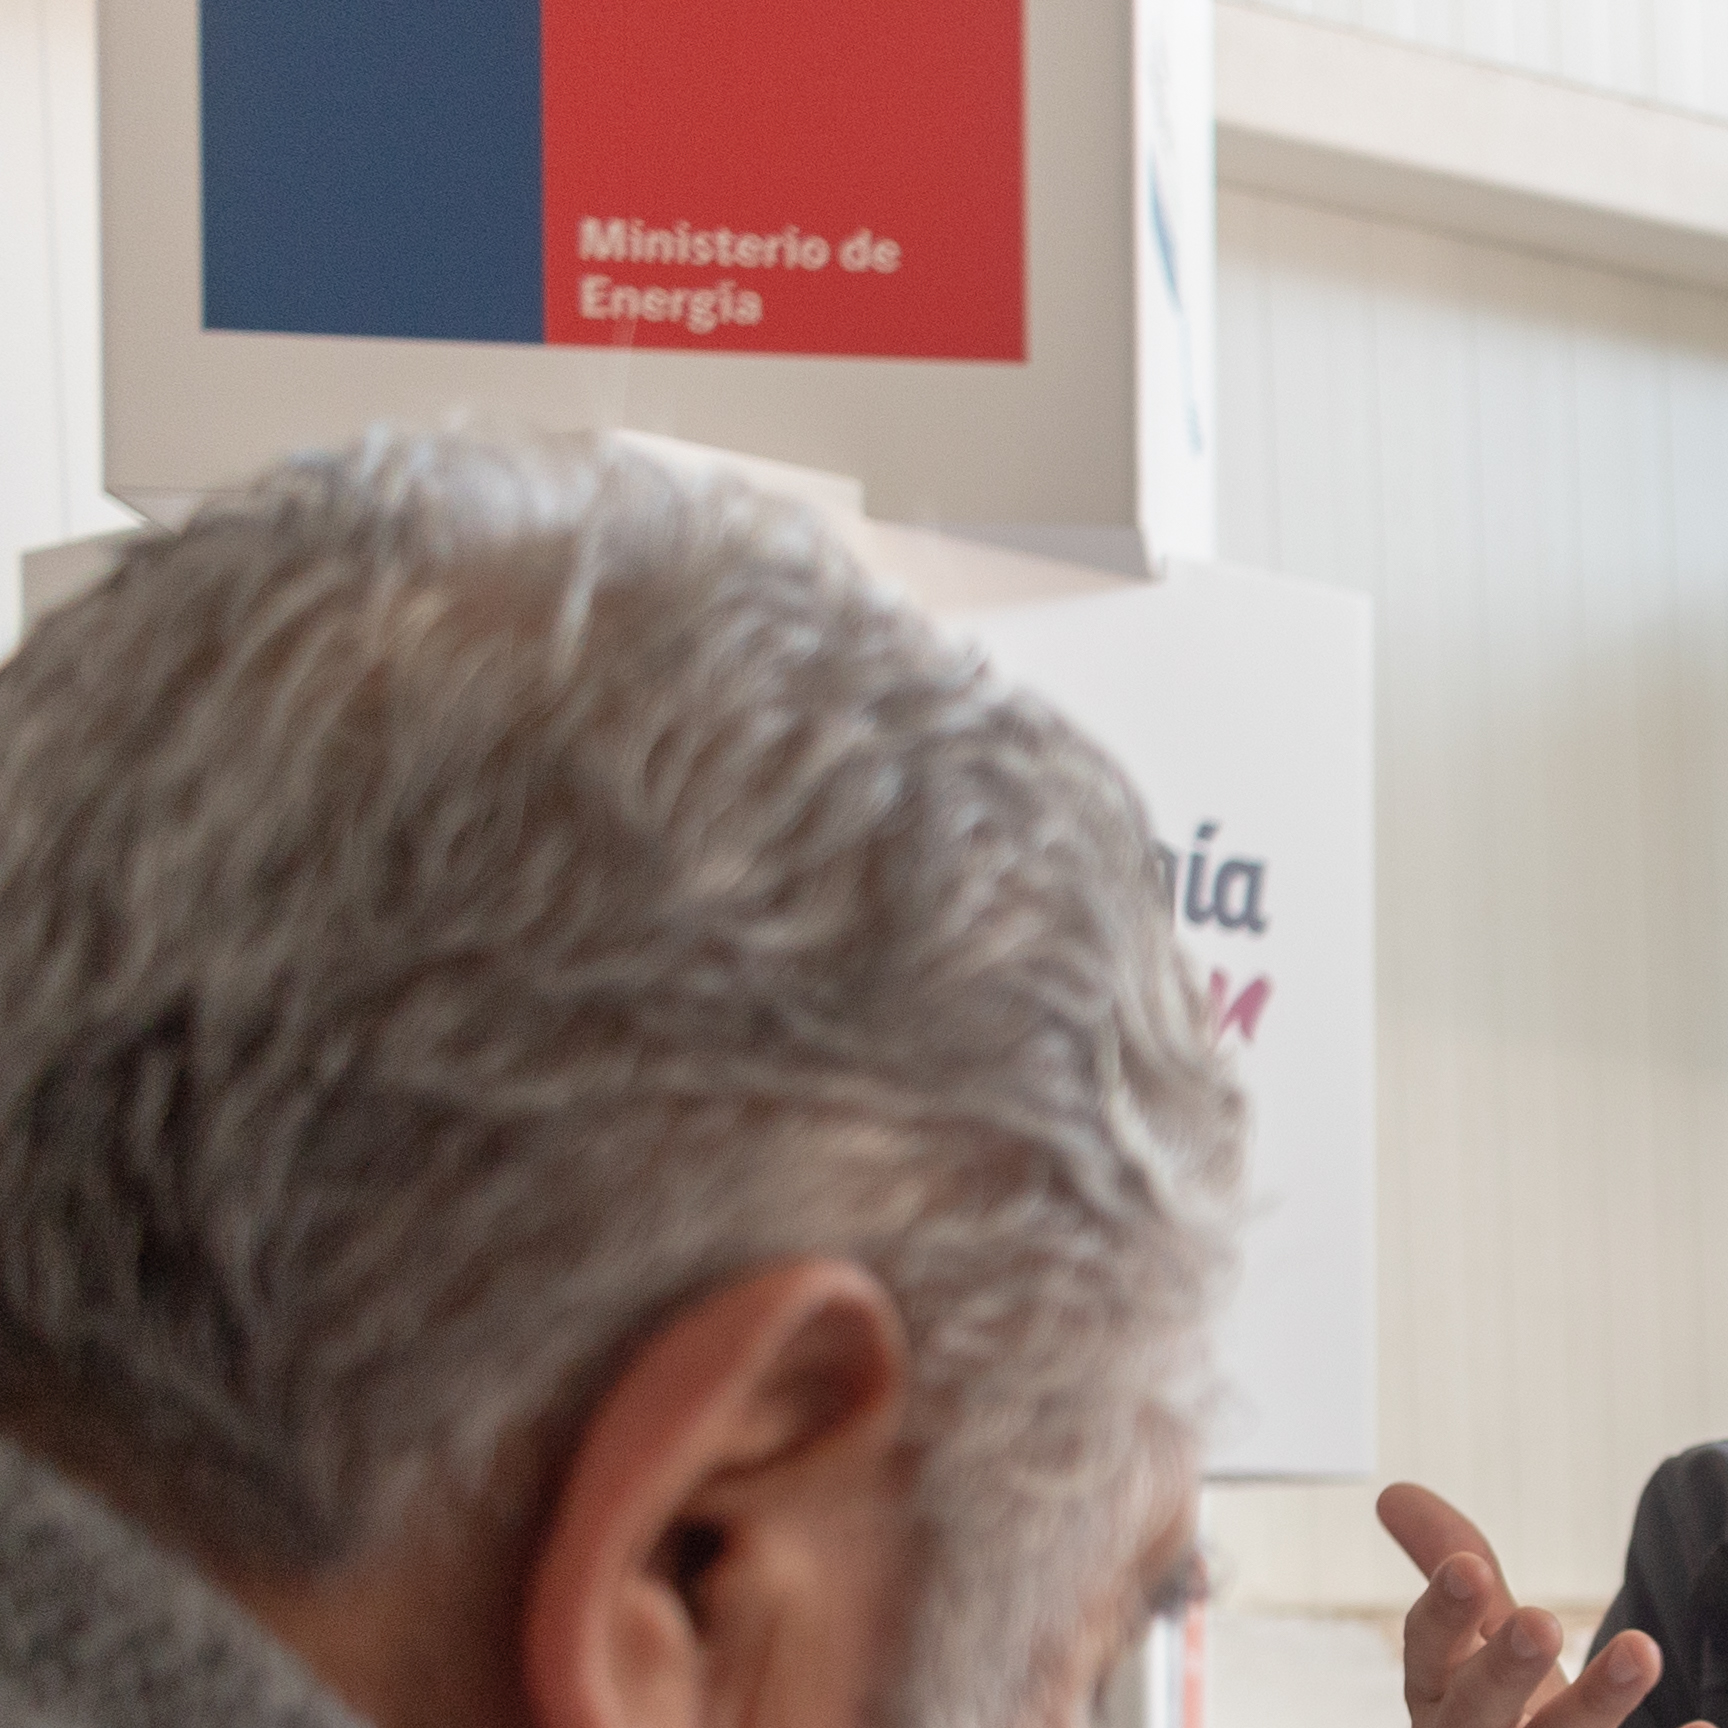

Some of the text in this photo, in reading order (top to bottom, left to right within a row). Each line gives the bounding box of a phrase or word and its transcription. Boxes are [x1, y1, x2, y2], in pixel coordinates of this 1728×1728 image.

[579, 216, 901, 274] Ministerio de
[579, 274, 763, 334] Energía
